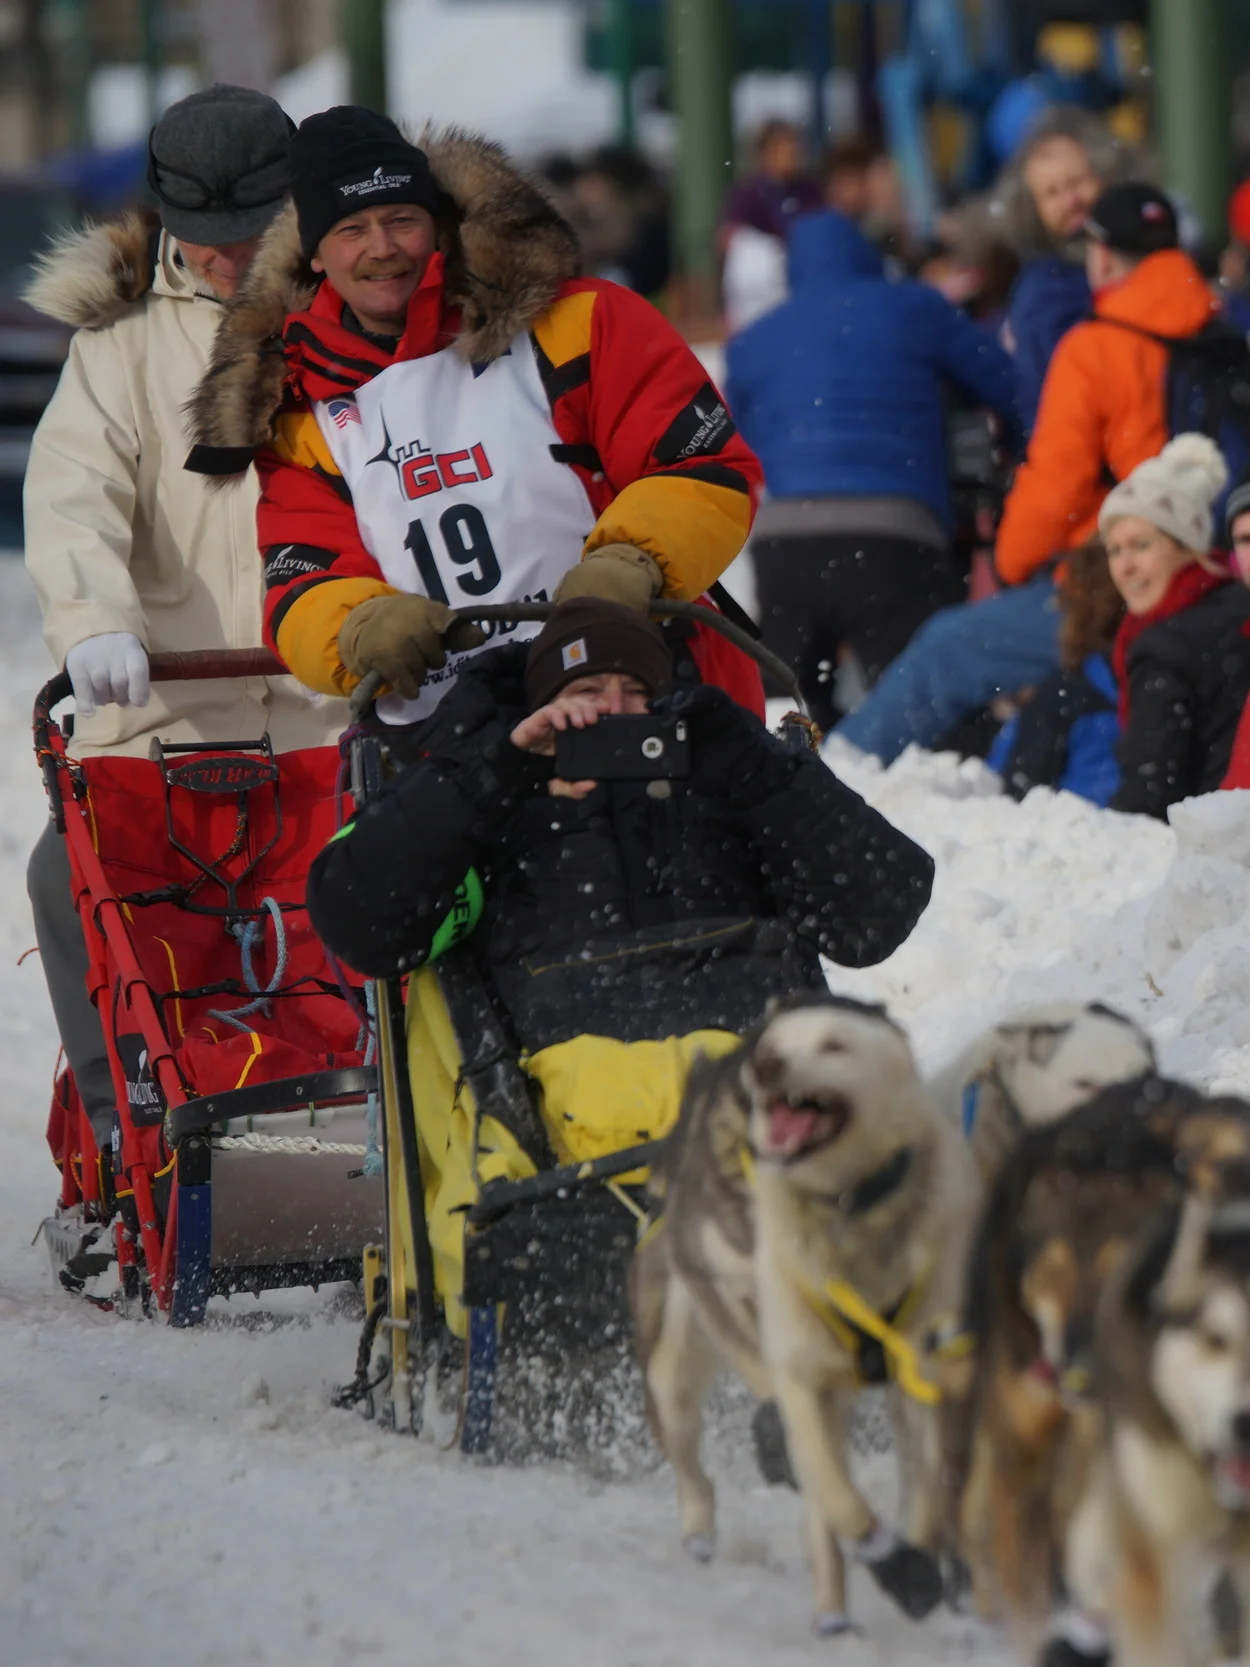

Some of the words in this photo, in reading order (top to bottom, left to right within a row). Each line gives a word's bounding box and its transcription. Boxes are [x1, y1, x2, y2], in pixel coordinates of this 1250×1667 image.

[339, 179, 373, 196] YOUNG
[379, 174, 412, 185] LIVING
[401, 441, 494, 500] GCI
[403, 503, 502, 607] 19
